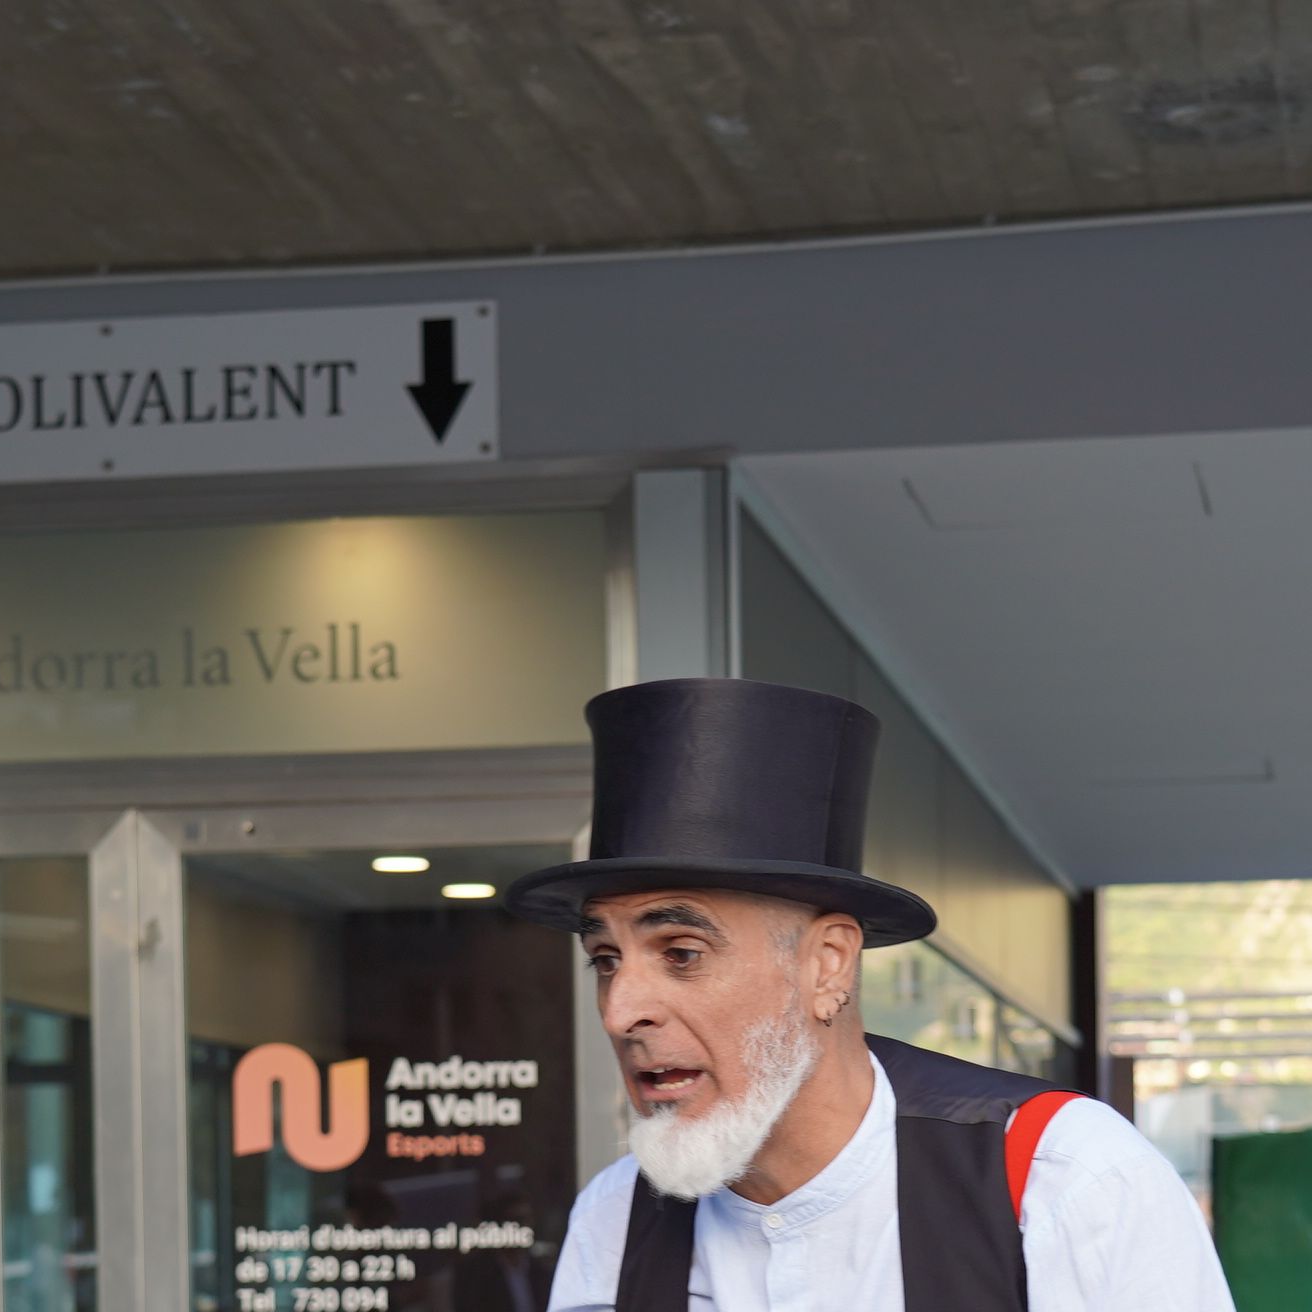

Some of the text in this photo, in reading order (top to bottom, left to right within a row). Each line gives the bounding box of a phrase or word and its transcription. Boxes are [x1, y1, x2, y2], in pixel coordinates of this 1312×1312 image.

[181, 630, 232, 689] la
[243, 623, 402, 684] Vella
[386, 1056, 538, 1090] Andorra
[386, 1093, 522, 1127] la Vella
[387, 1133, 485, 1161] Esports
[235, 1225, 310, 1252] Horari
[432, 1222, 458, 1249] al
[459, 1221, 535, 1253] públic
[235, 1256, 269, 1283] de
[341, 1260, 360, 1282] a
[361, 1254, 395, 1282] 22
[396, 1253, 416, 1281] h
